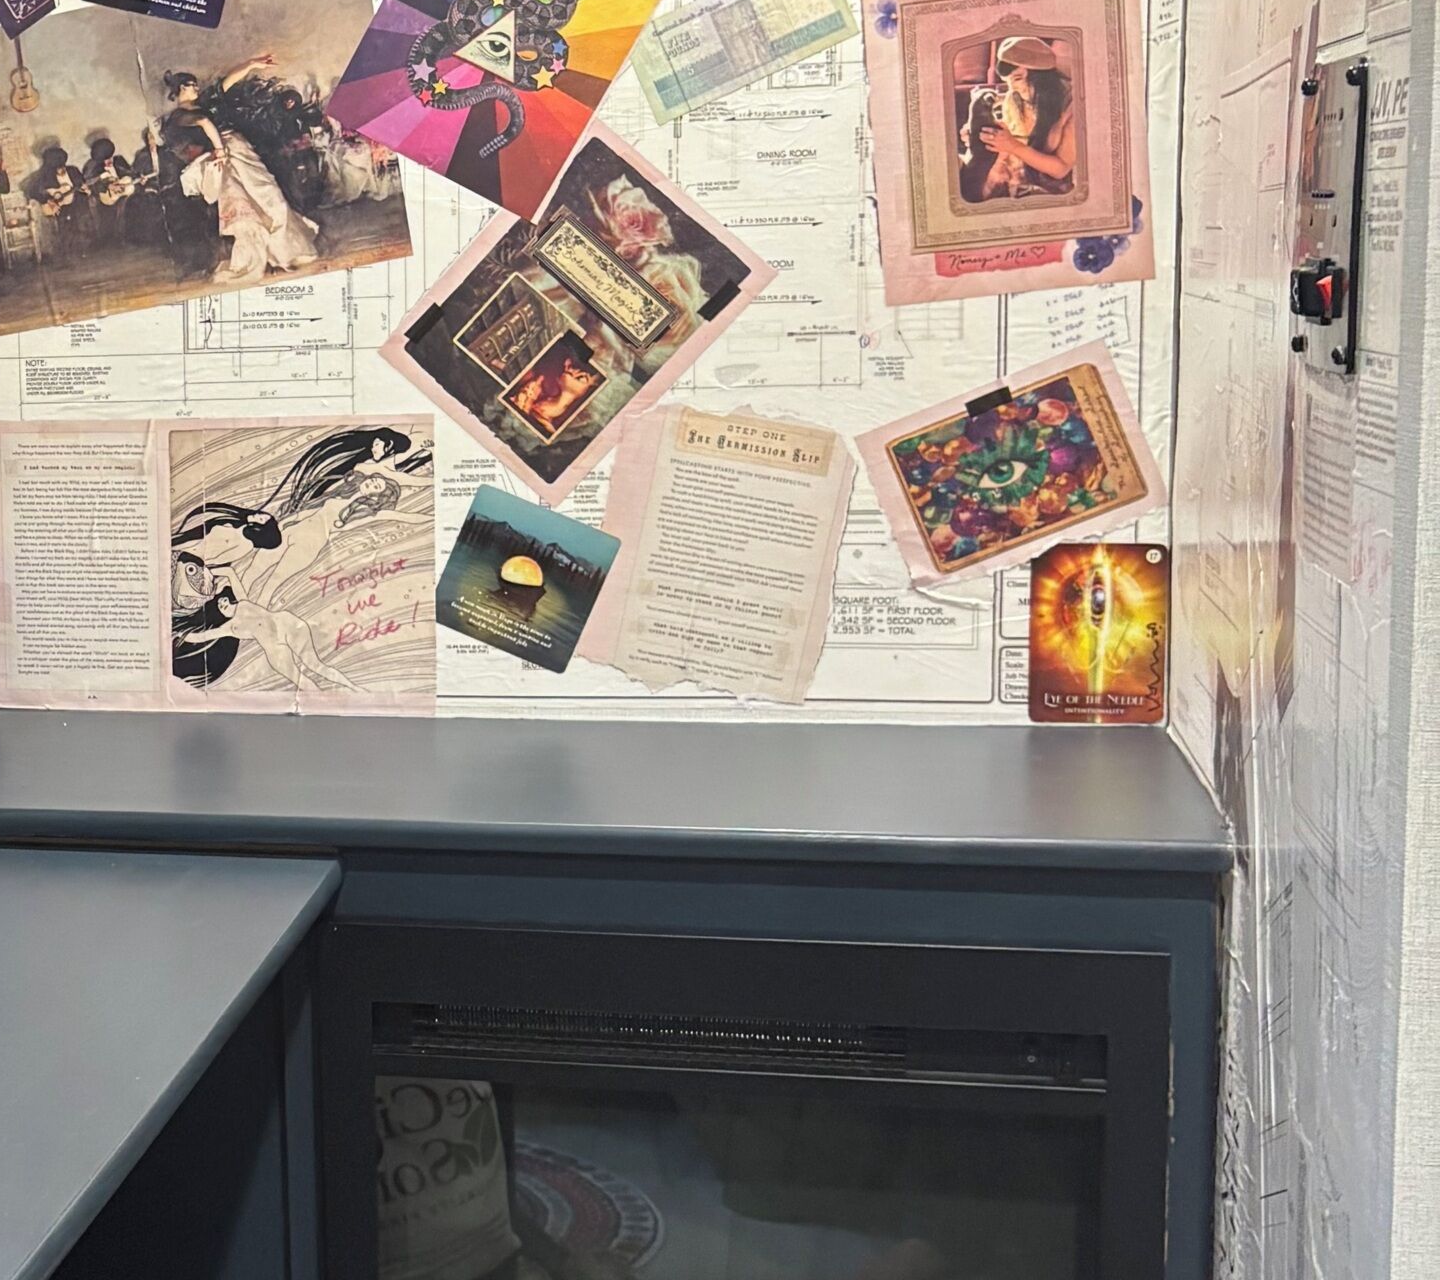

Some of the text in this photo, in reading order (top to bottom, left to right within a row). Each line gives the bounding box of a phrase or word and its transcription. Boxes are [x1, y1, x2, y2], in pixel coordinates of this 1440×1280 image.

[756, 149, 817, 160] DINING ROOM
[265, 285, 314, 295] BEDROOM 3
[762, 430, 788, 442] ONE
[1149, 552, 1159, 561] 17
[308, 558, 409, 598] Tonight
[346, 593, 383, 615] we
[886, 606, 912, 615] FIRST
[914, 607, 944, 616] FLOOR
[886, 616, 924, 626] SECOND
[926, 616, 957, 626] FLOOR
[888, 626, 916, 635] TOTAL
[1044, 692, 1061, 708] EYE
[1066, 694, 1079, 705] OF
[1107, 693, 1144, 706] NEEDLE
